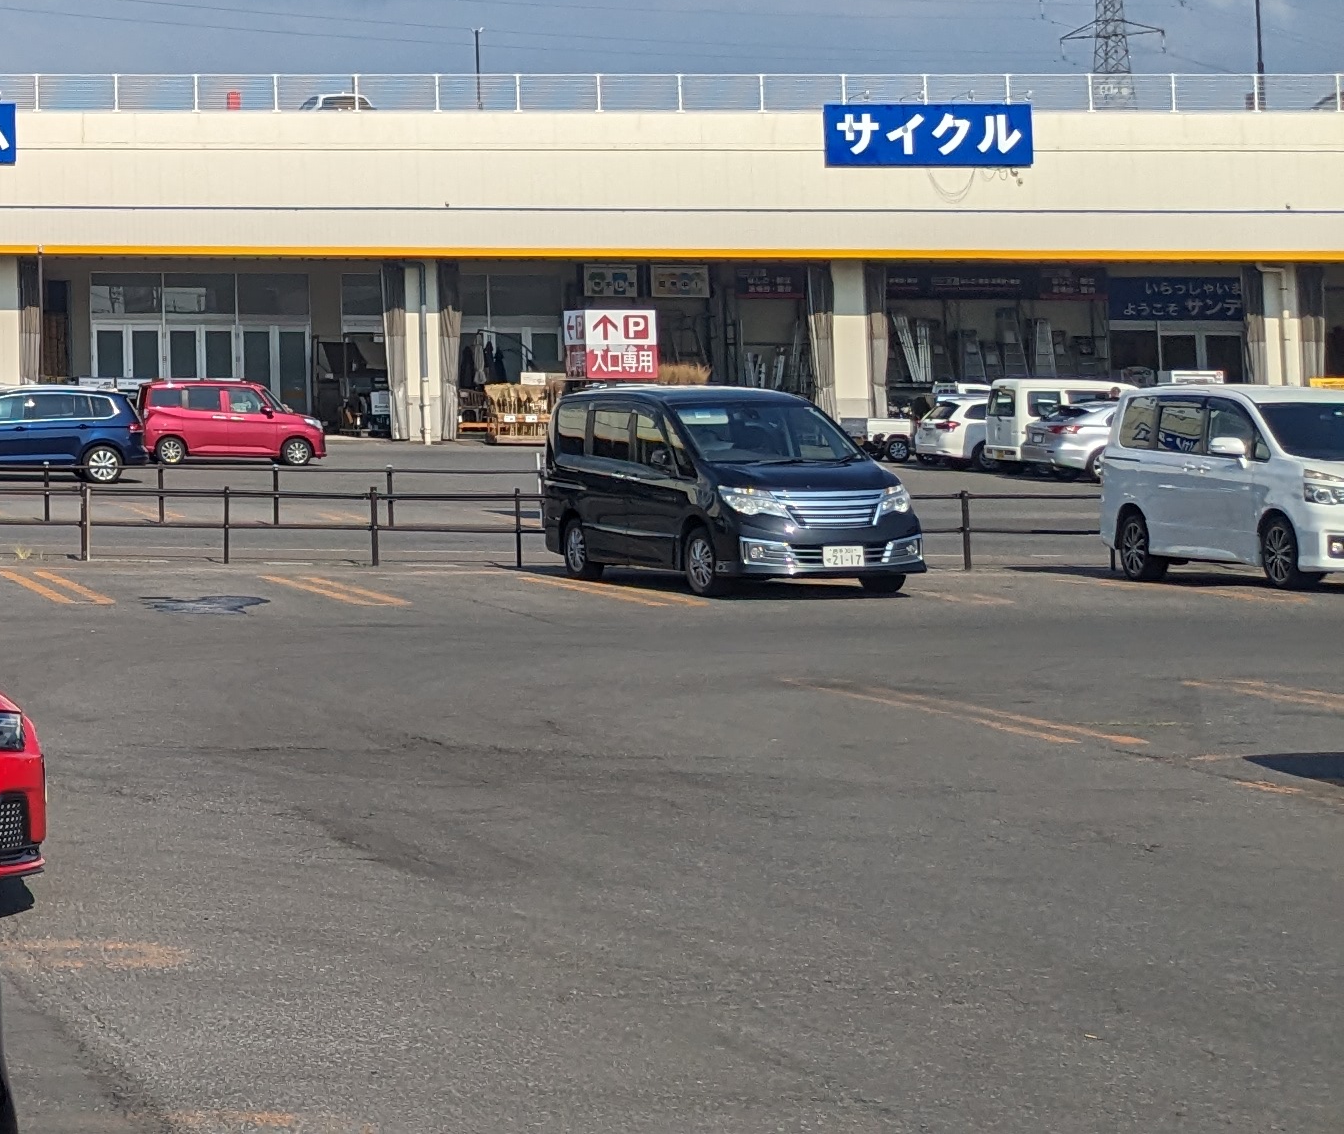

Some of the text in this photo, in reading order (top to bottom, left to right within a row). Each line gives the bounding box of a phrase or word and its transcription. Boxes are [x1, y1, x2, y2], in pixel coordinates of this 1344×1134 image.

[836, 113, 1022, 155] サイクル
[628, 317, 645, 338] P
[591, 350, 654, 373] 入口専用
